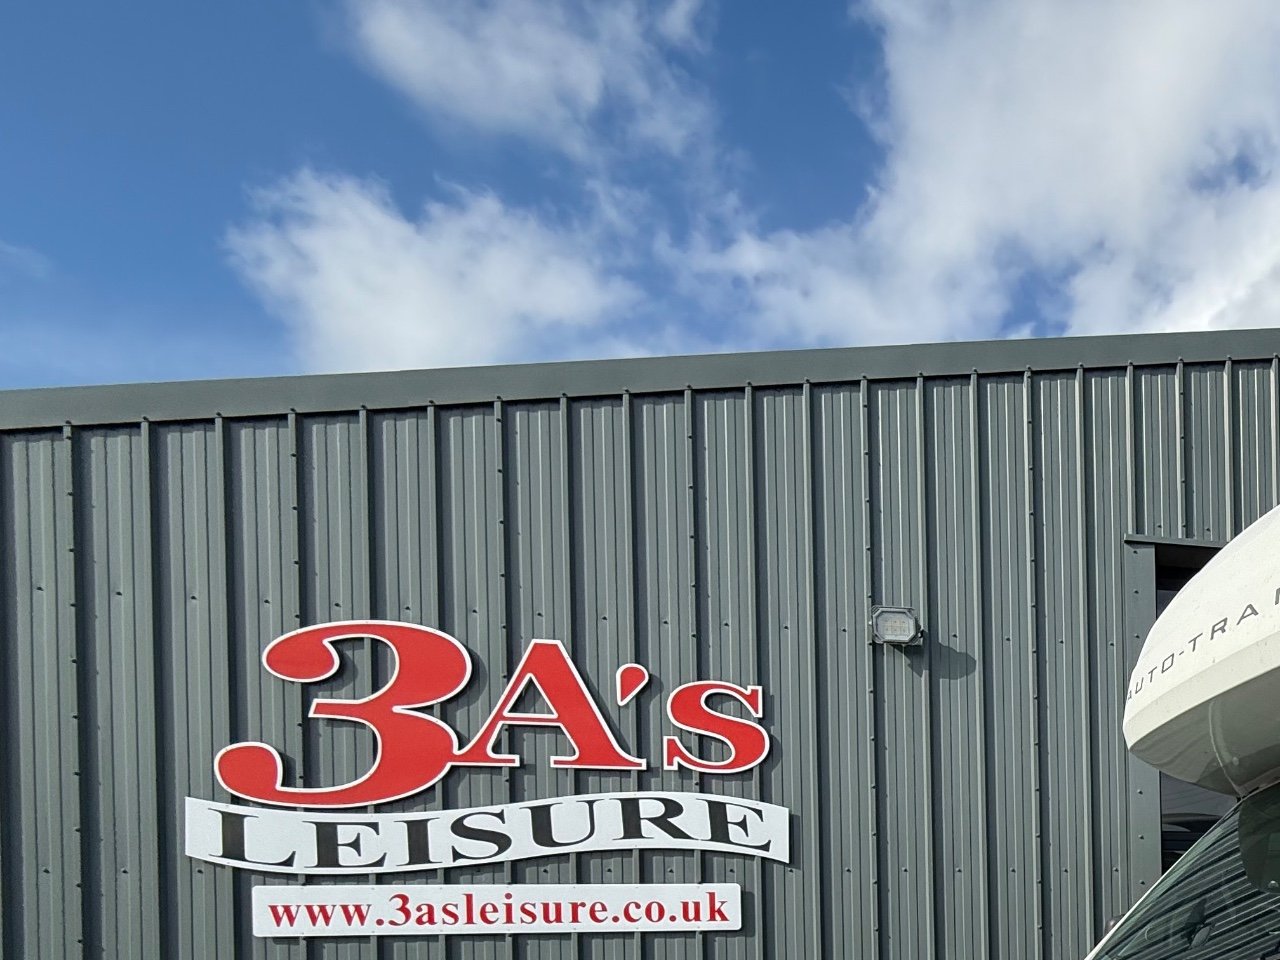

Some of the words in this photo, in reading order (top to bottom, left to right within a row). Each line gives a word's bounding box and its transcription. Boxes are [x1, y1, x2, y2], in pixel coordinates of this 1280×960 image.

[214, 620, 770, 807] 3A's
[208, 797, 772, 868] LEISURE
[268, 892, 730, 928] www.3asleisure.co.uk
